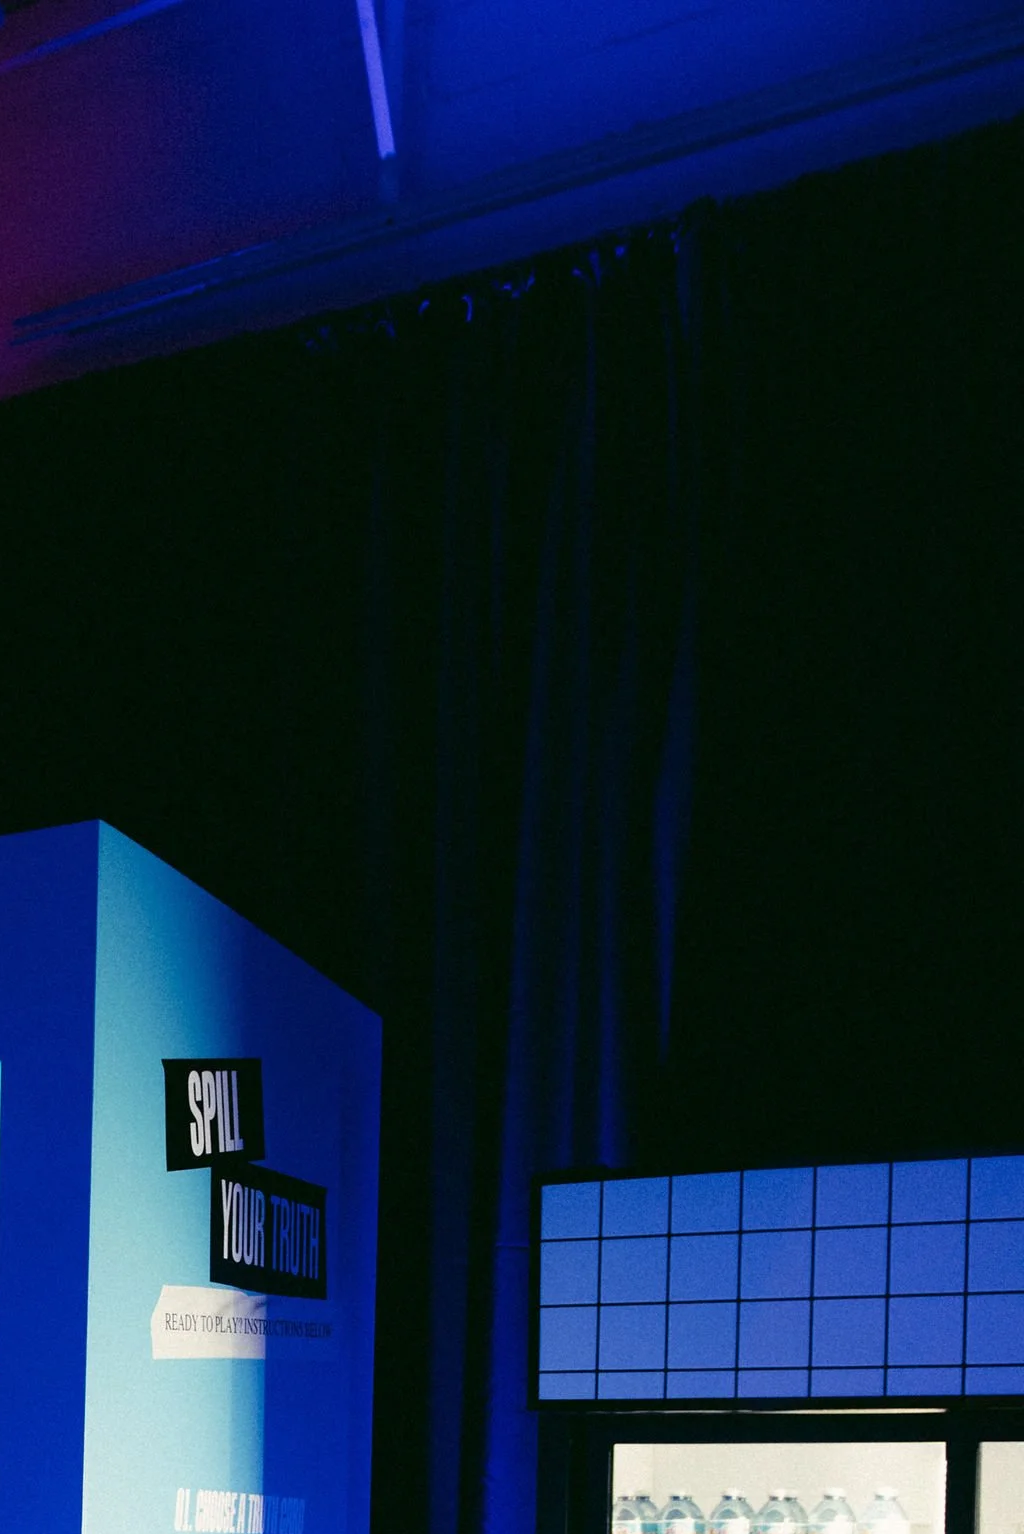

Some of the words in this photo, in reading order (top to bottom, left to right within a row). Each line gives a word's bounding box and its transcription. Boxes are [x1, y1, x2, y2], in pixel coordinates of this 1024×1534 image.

[188, 1070, 244, 1157] SPILL
[221, 1178, 265, 1268] YOUR
[270, 1195, 320, 1280] TRUTH
[165, 1312, 199, 1332] READY
[200, 1315, 214, 1333] TO
[215, 1315, 243, 1335] PLAY?
[244, 1317, 304, 1337] INSTRUCTIONS
[195, 1489, 237, 1533] CHOOSE
[237, 1493, 246, 1534] A
[247, 1493, 279, 1534] TRUTH
